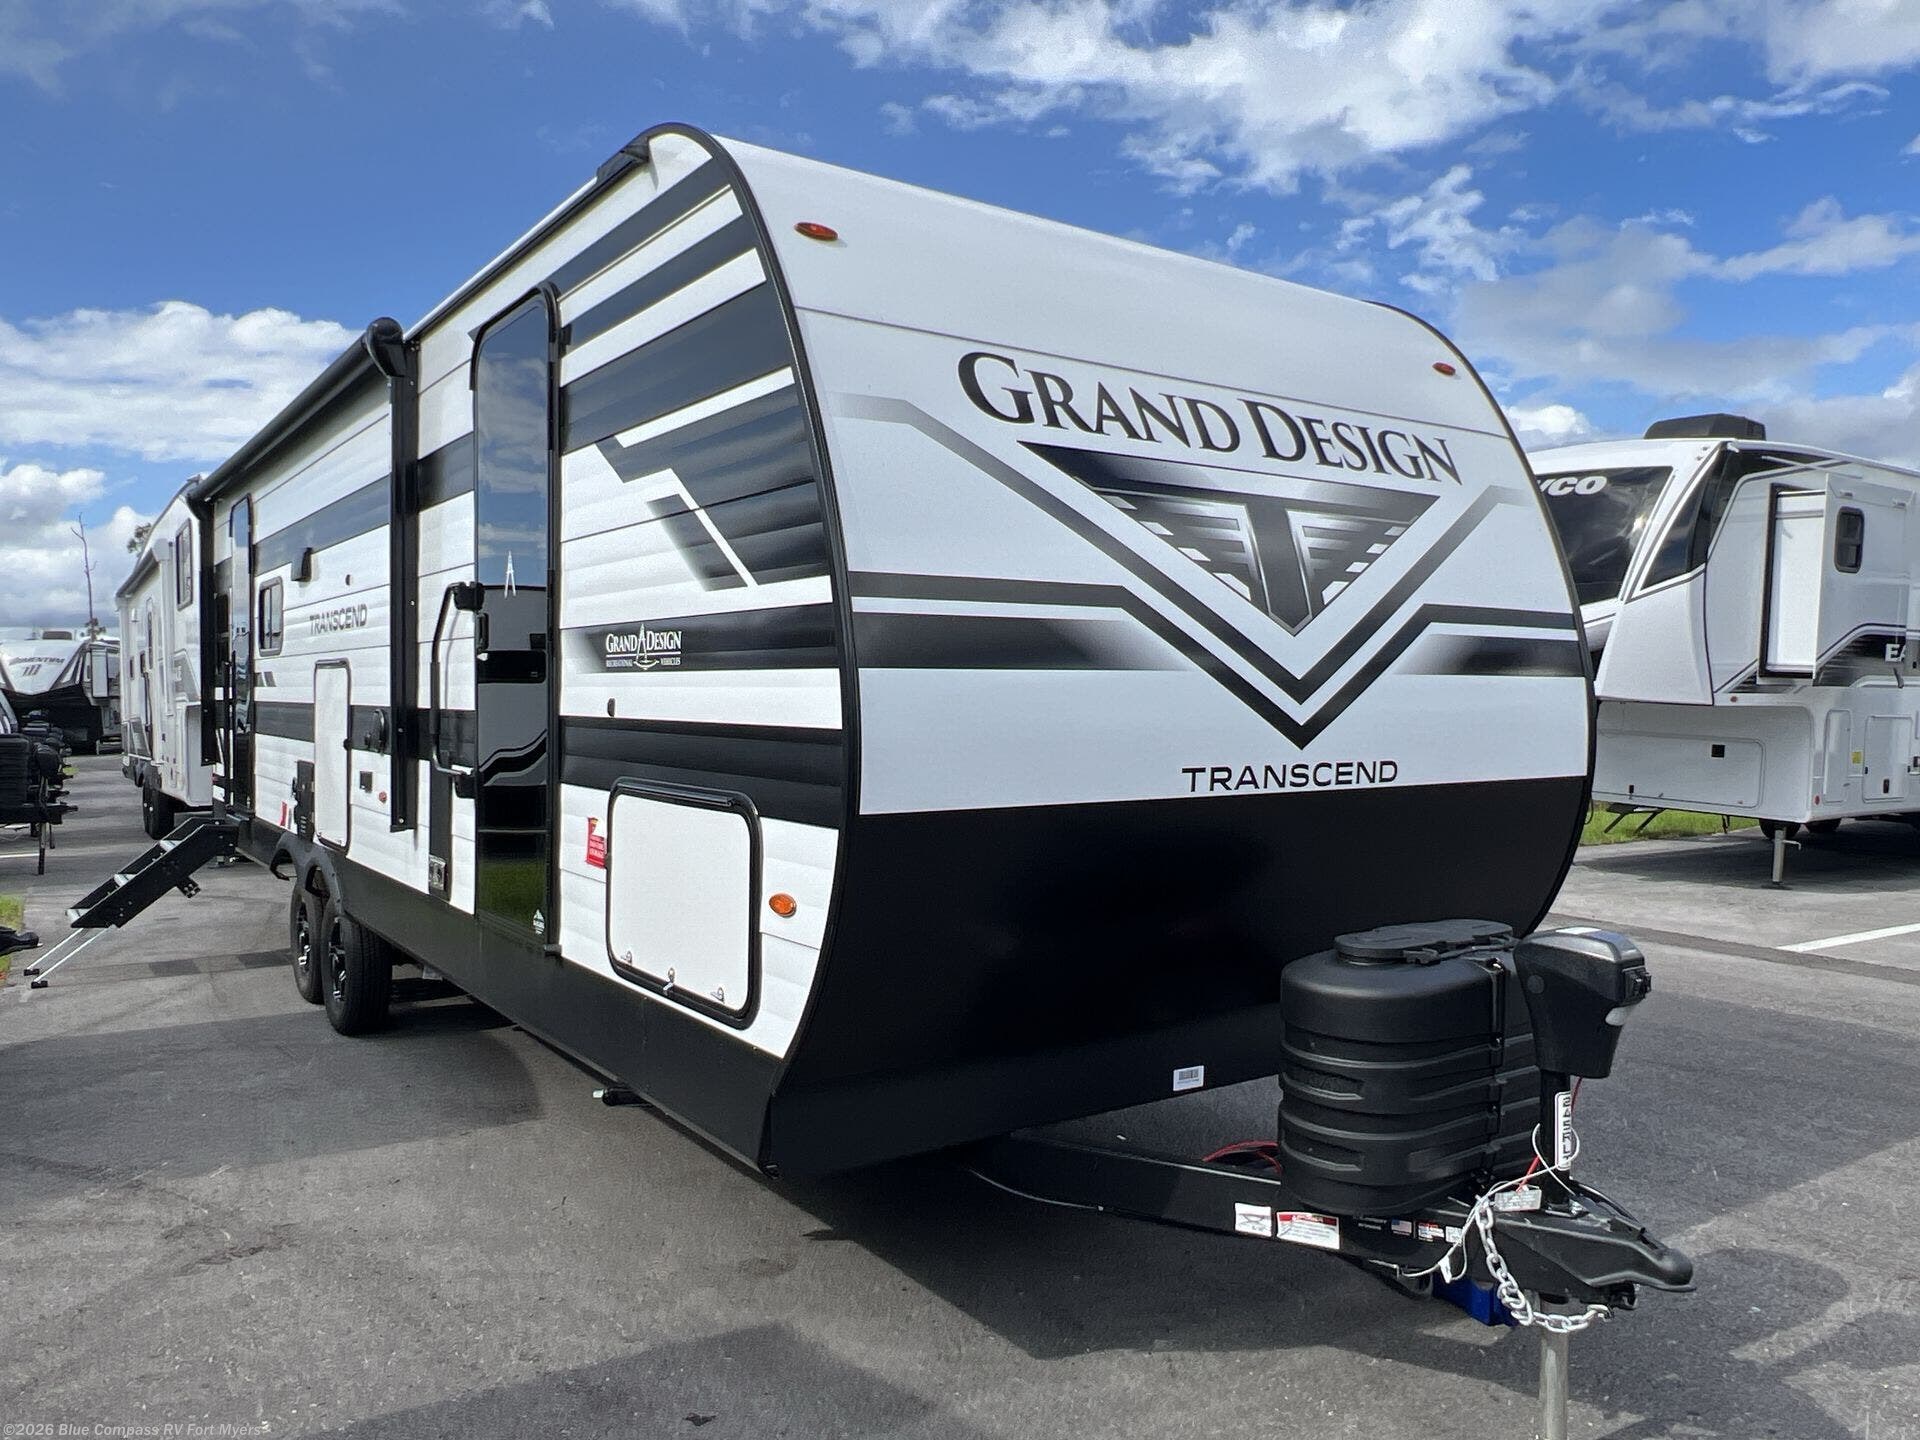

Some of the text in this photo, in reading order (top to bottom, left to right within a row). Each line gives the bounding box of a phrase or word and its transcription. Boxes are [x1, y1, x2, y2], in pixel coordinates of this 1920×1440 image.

[957, 350, 1463, 486] GRAND DESIGN
[309, 603, 368, 635] TRANSCEND
[605, 630, 682, 653] GRAND DESIGN
[1181, 760, 1398, 793] TRANSCEND
